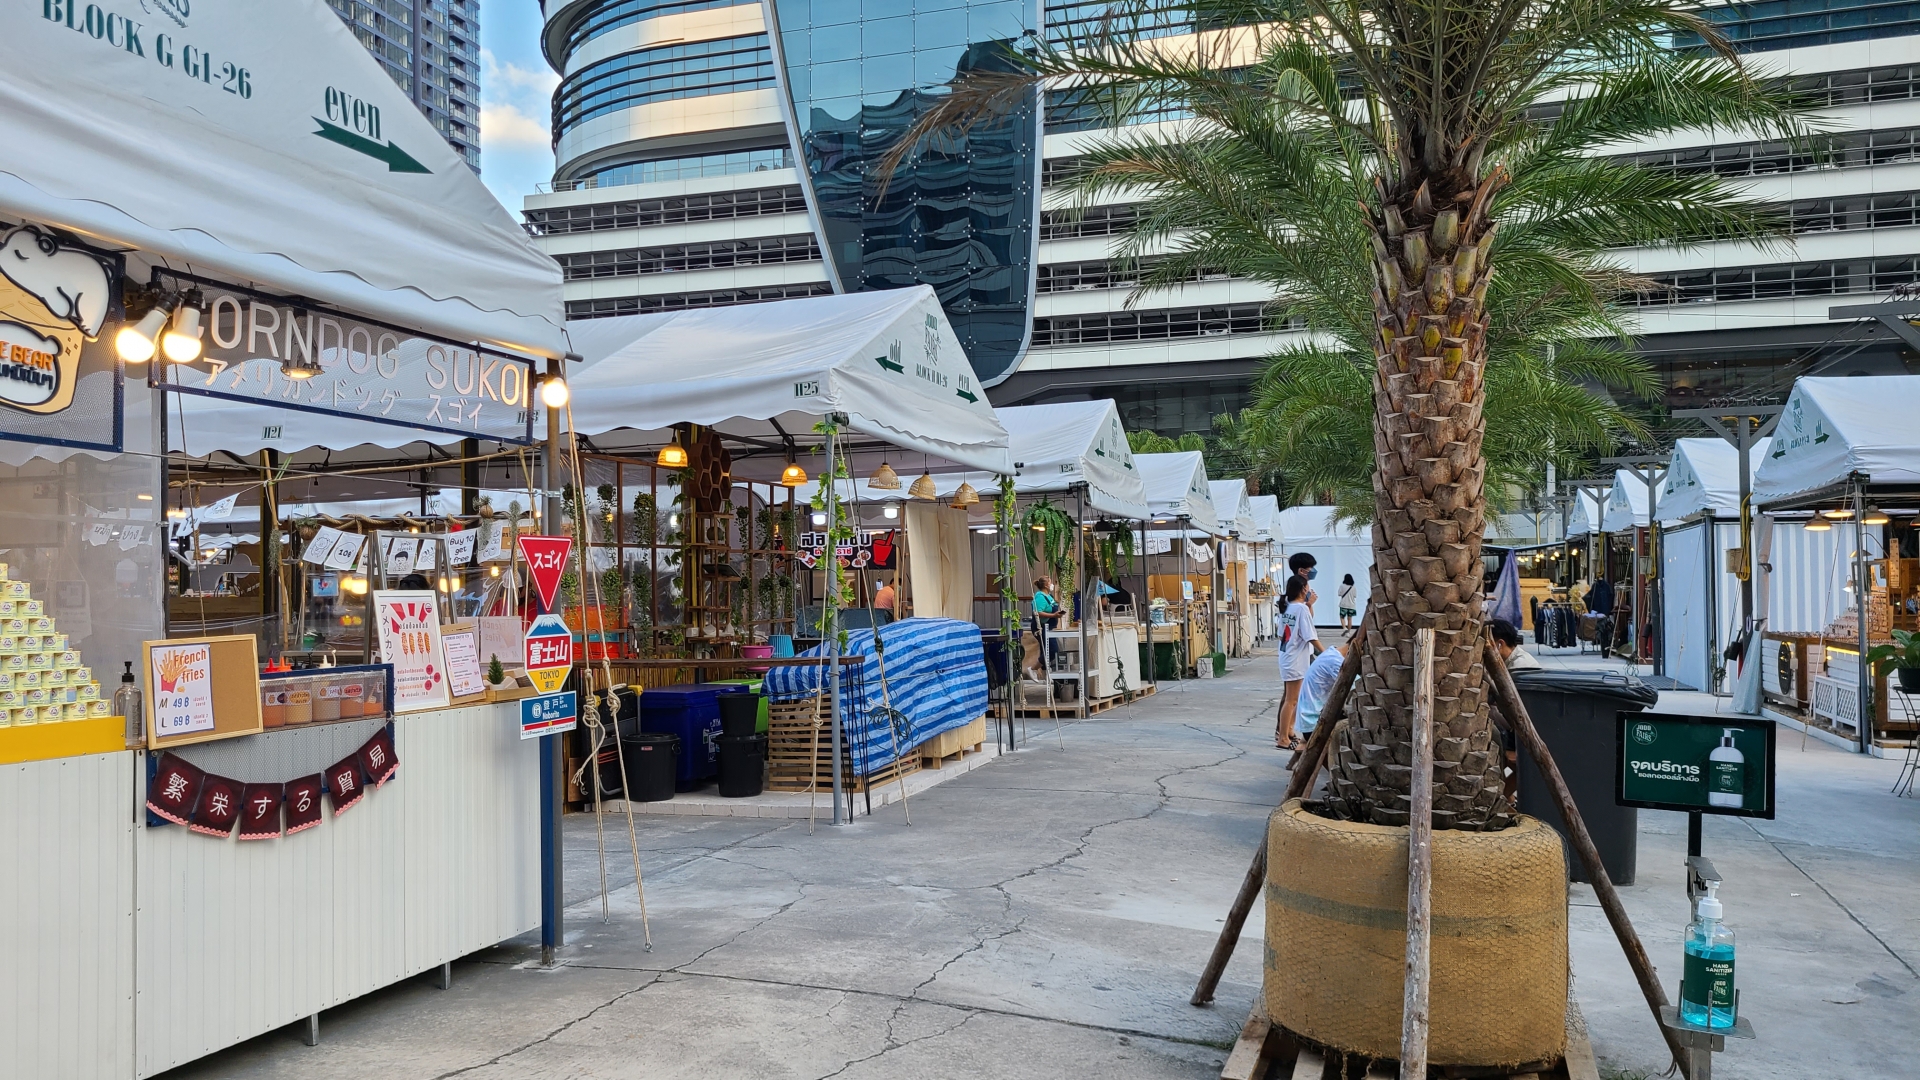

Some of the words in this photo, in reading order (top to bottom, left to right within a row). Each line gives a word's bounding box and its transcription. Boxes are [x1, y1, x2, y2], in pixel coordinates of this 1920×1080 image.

[41, 0, 146, 58] BLOCK
[156, 33, 174, 69] G
[183, 44, 252, 100] G1-26
[325, 84, 382, 141] even
[11, 345, 54, 371] BEAR
[426, 394, 483, 430] スゴイ
[517, 410, 539, 425] H3
[450, 538, 464, 546] Buy
[466, 534, 474, 543] 10
[454, 546, 467, 556] get
[454, 555, 469, 563] free
[533, 550, 562, 570] スゴイ
[174, 648, 207, 667] French
[529, 639, 568, 666] 富士山
[182, 668, 204, 683] fries
[539, 670, 560, 680] TOKYO
[159, 697, 168, 709] M
[173, 697, 182, 708] 49
[161, 717, 168, 728] L
[173, 715, 183, 727] 69
[1636, 730, 1652, 741] FAIRS
[1630, 760, 1700, 774] จุดบริการ
